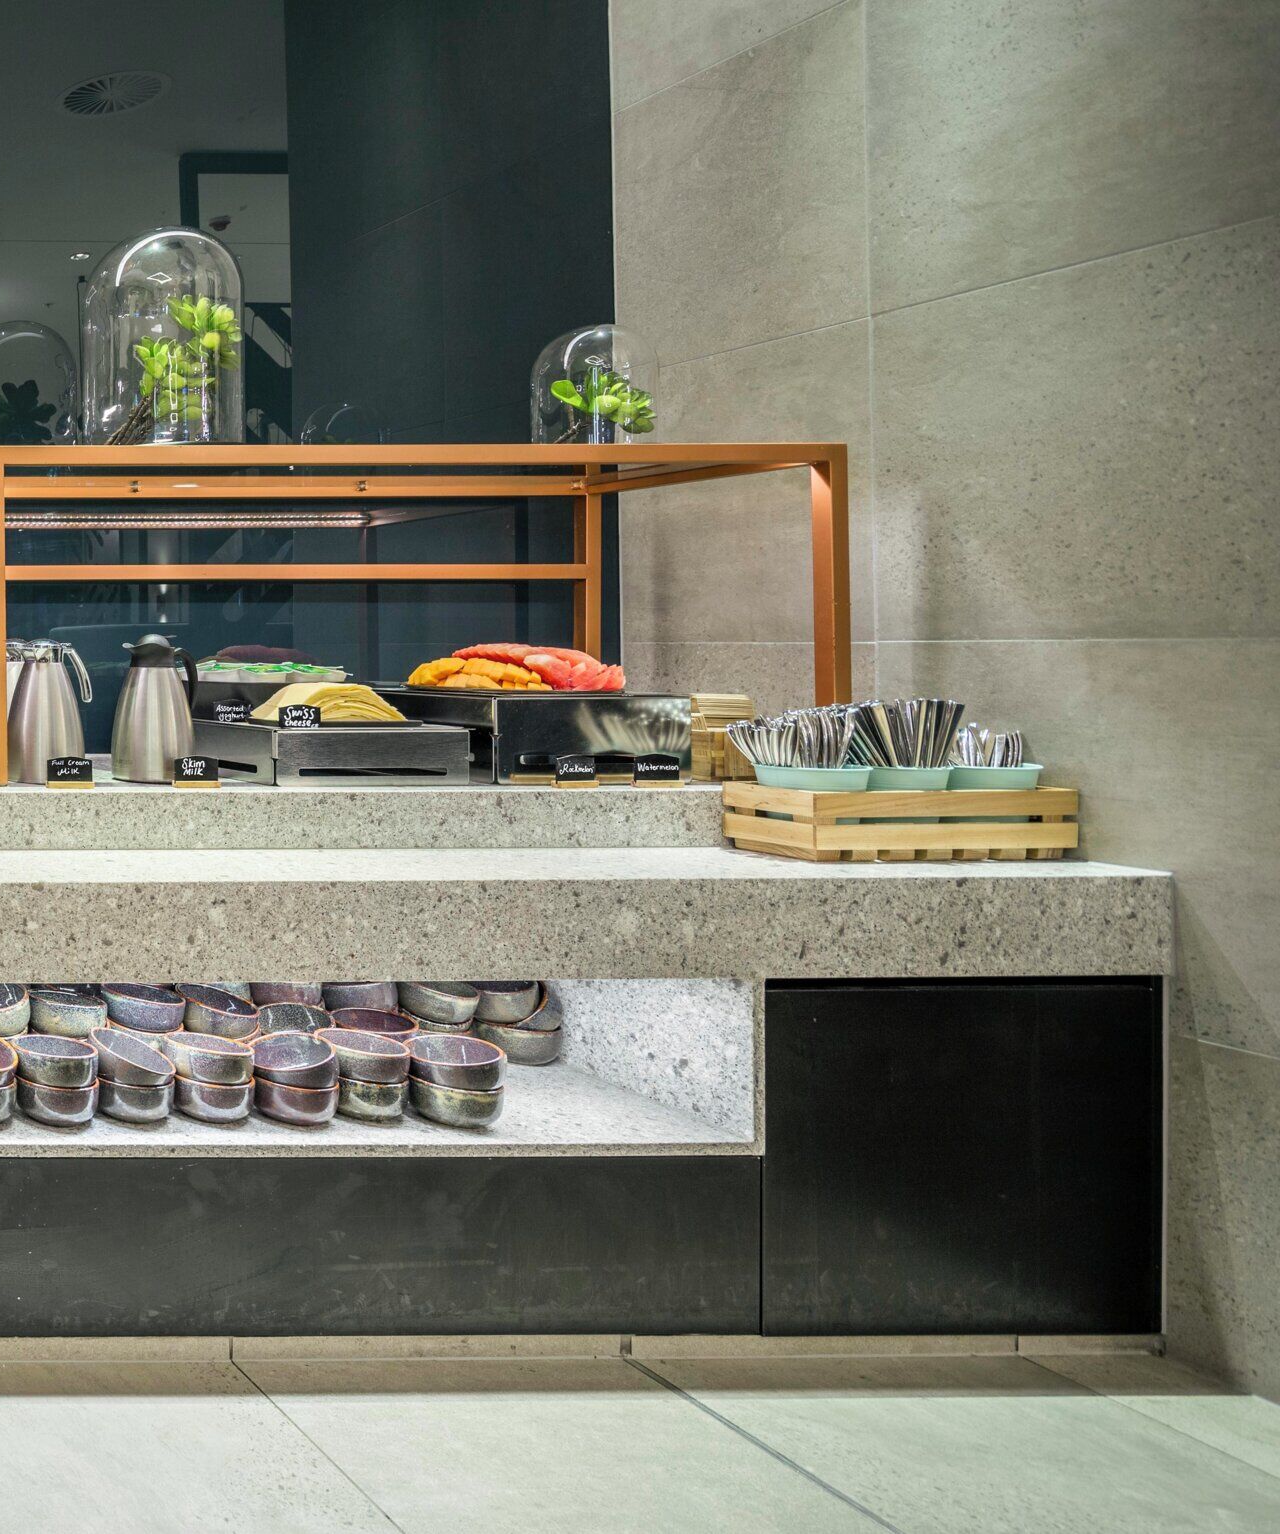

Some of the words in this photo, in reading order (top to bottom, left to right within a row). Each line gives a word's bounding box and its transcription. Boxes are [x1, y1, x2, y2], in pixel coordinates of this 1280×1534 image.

[216, 704, 244, 712] Assorted
[284, 706, 315, 720] Swiss
[182, 758, 206, 770] Skim
[560, 764, 594, 775] Rockmelon
[638, 763, 680, 772] Watermelon
